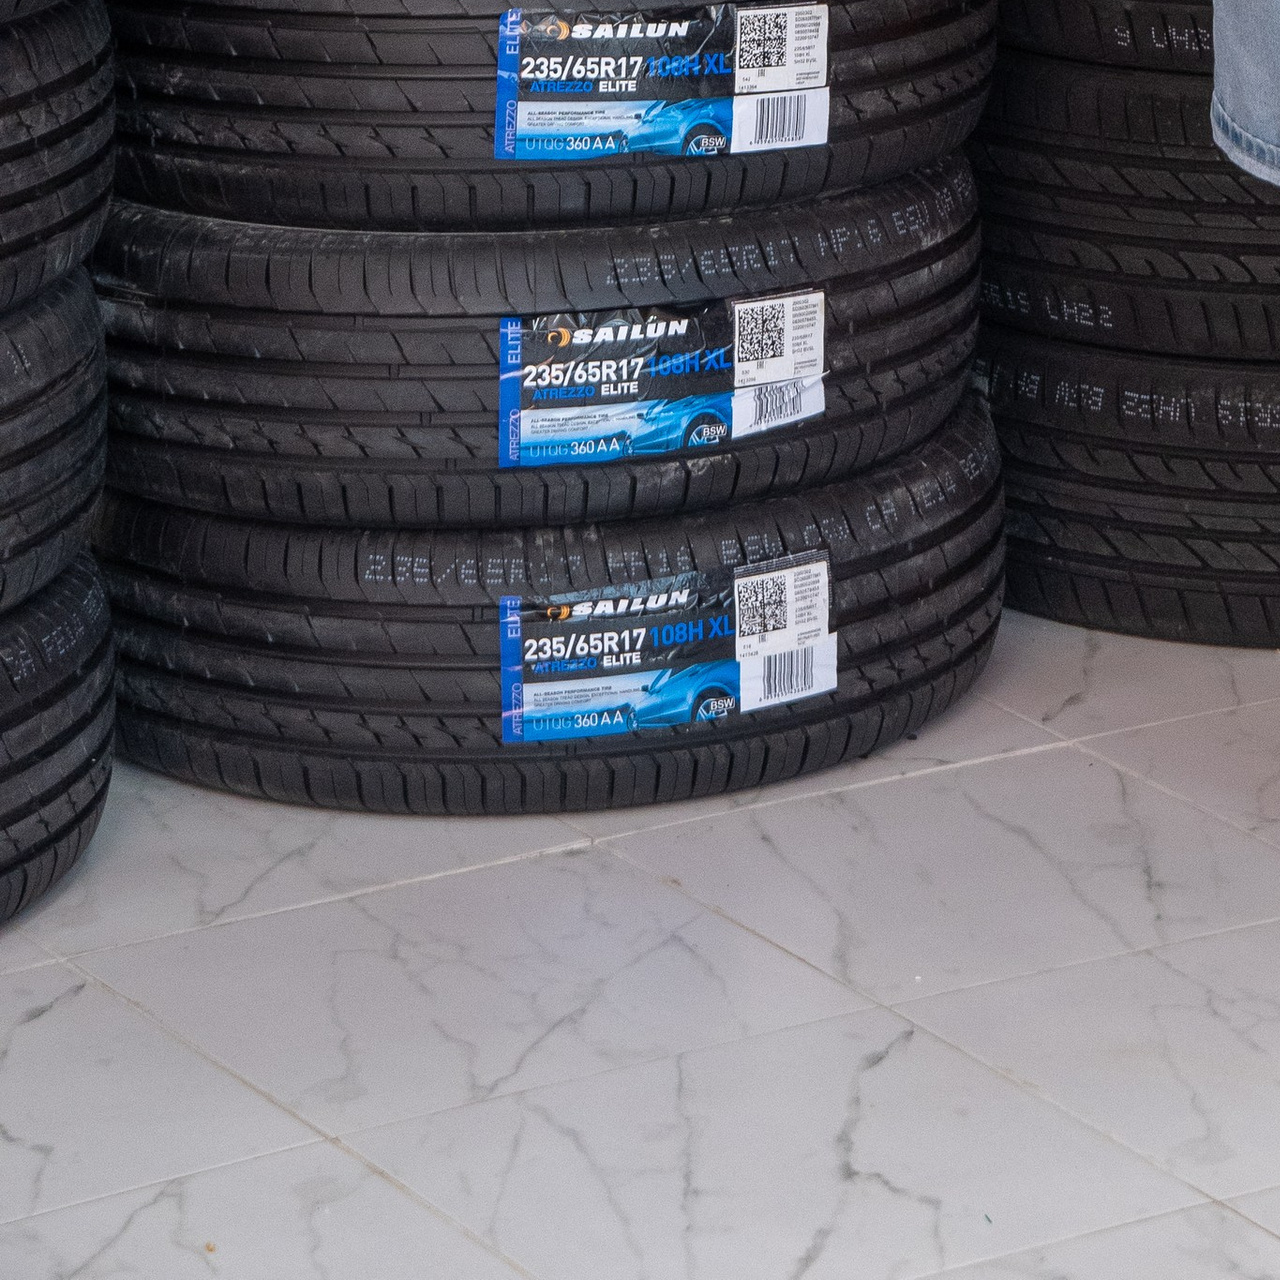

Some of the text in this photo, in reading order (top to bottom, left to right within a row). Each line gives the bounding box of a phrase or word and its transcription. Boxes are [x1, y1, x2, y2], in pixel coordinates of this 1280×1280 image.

[571, 22, 689, 39] SAILUN
[522, 53, 731, 79] 235/65R17 108H XL
[506, 11, 520, 153] ATREZZO ELITE
[530, 81, 637, 92] ATREZZO ELITE
[701, 138, 725, 147] BSW
[572, 320, 688, 344] SAILUN
[523, 348, 731, 388] 235/65R17 108H XL
[508, 321, 521, 461] ATREZZO ELITE
[532, 382, 638, 400] ATREZZO ELITE
[703, 425, 726, 436] BSW
[572, 590, 690, 615] SAILUN
[524, 616, 735, 661] 235/65R17 108H XL
[508, 599, 522, 735] ATREZZO ELITE
[533, 652, 641, 674] ATREZZO ELITE
[711, 699, 734, 709] BSW
